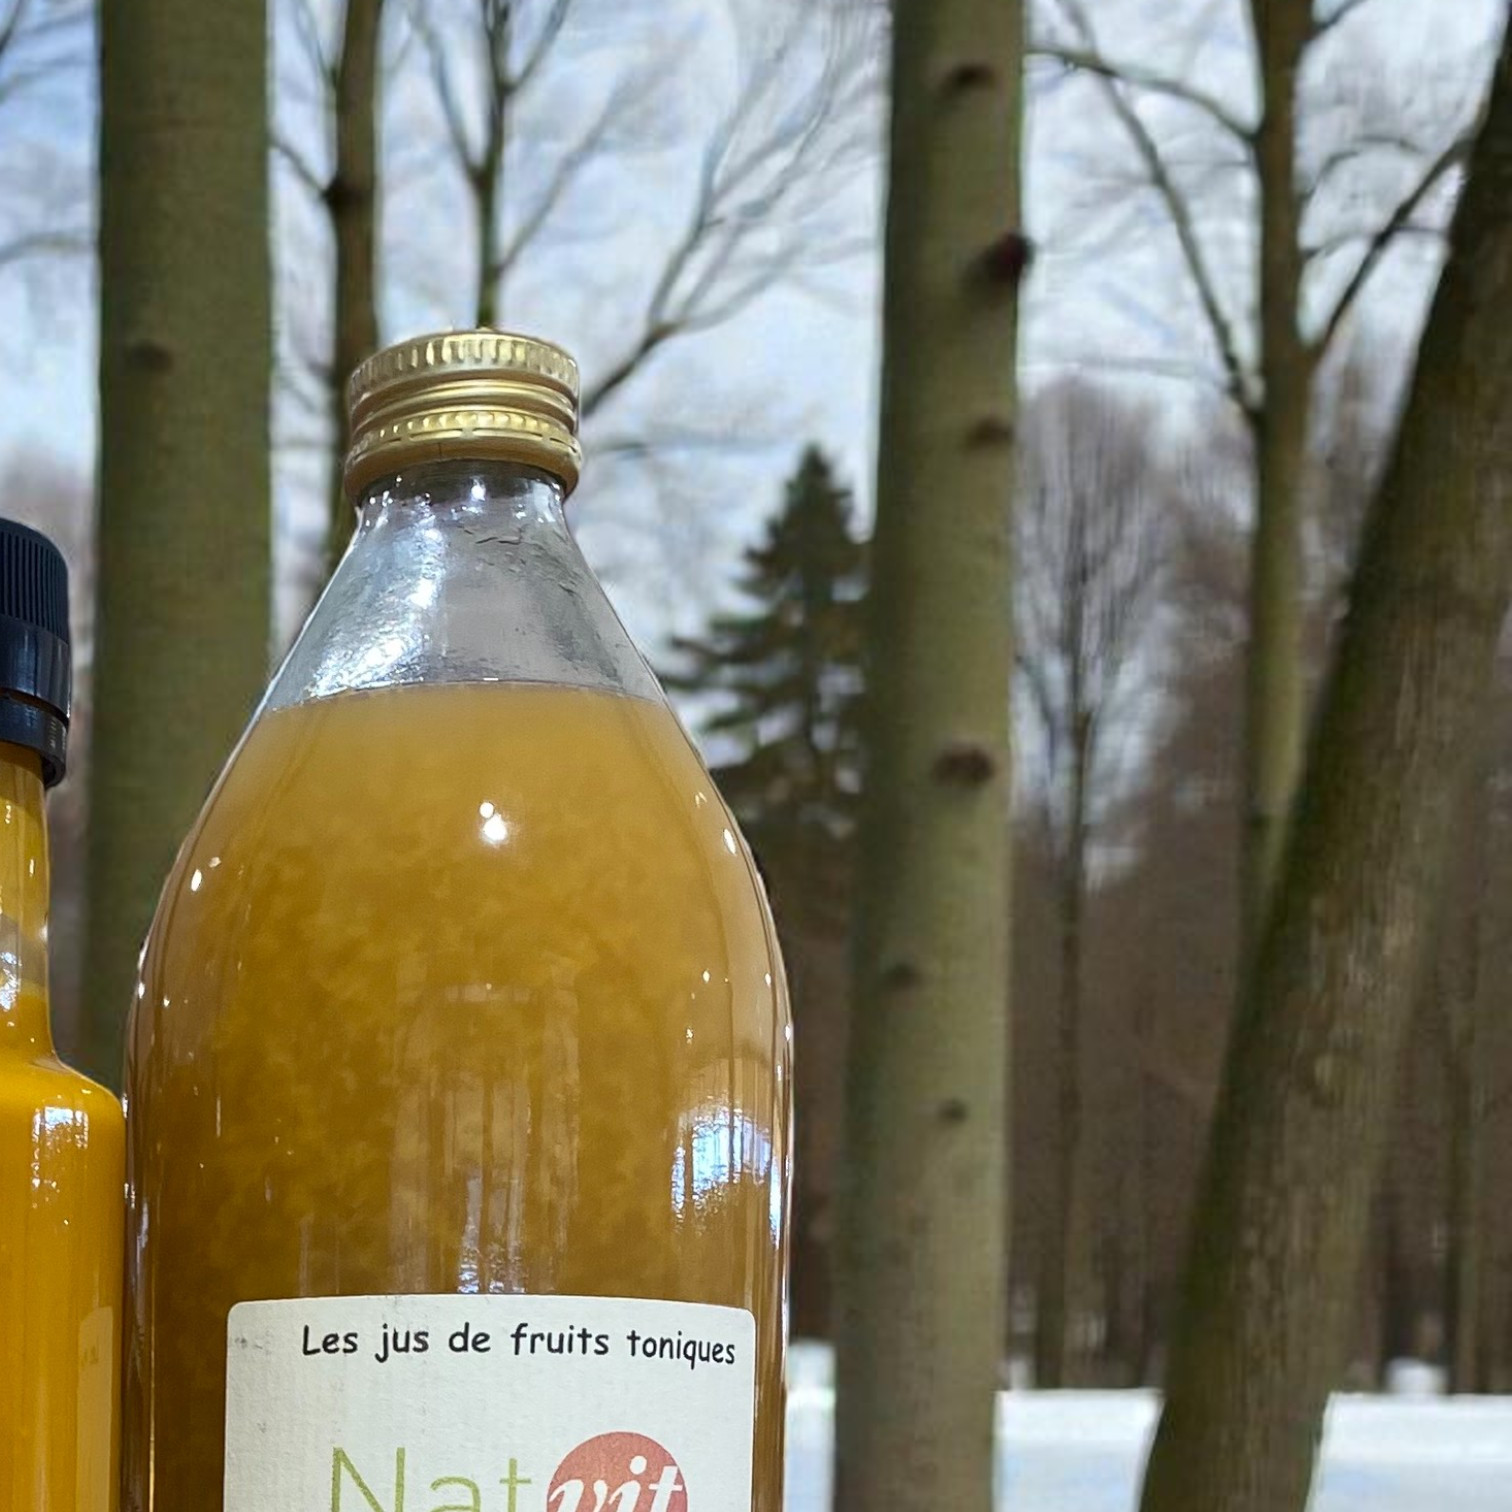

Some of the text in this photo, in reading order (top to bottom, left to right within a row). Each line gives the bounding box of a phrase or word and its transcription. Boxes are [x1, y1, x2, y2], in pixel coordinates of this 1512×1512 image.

[302, 1321, 736, 1371] Les jus de fruits toniques
